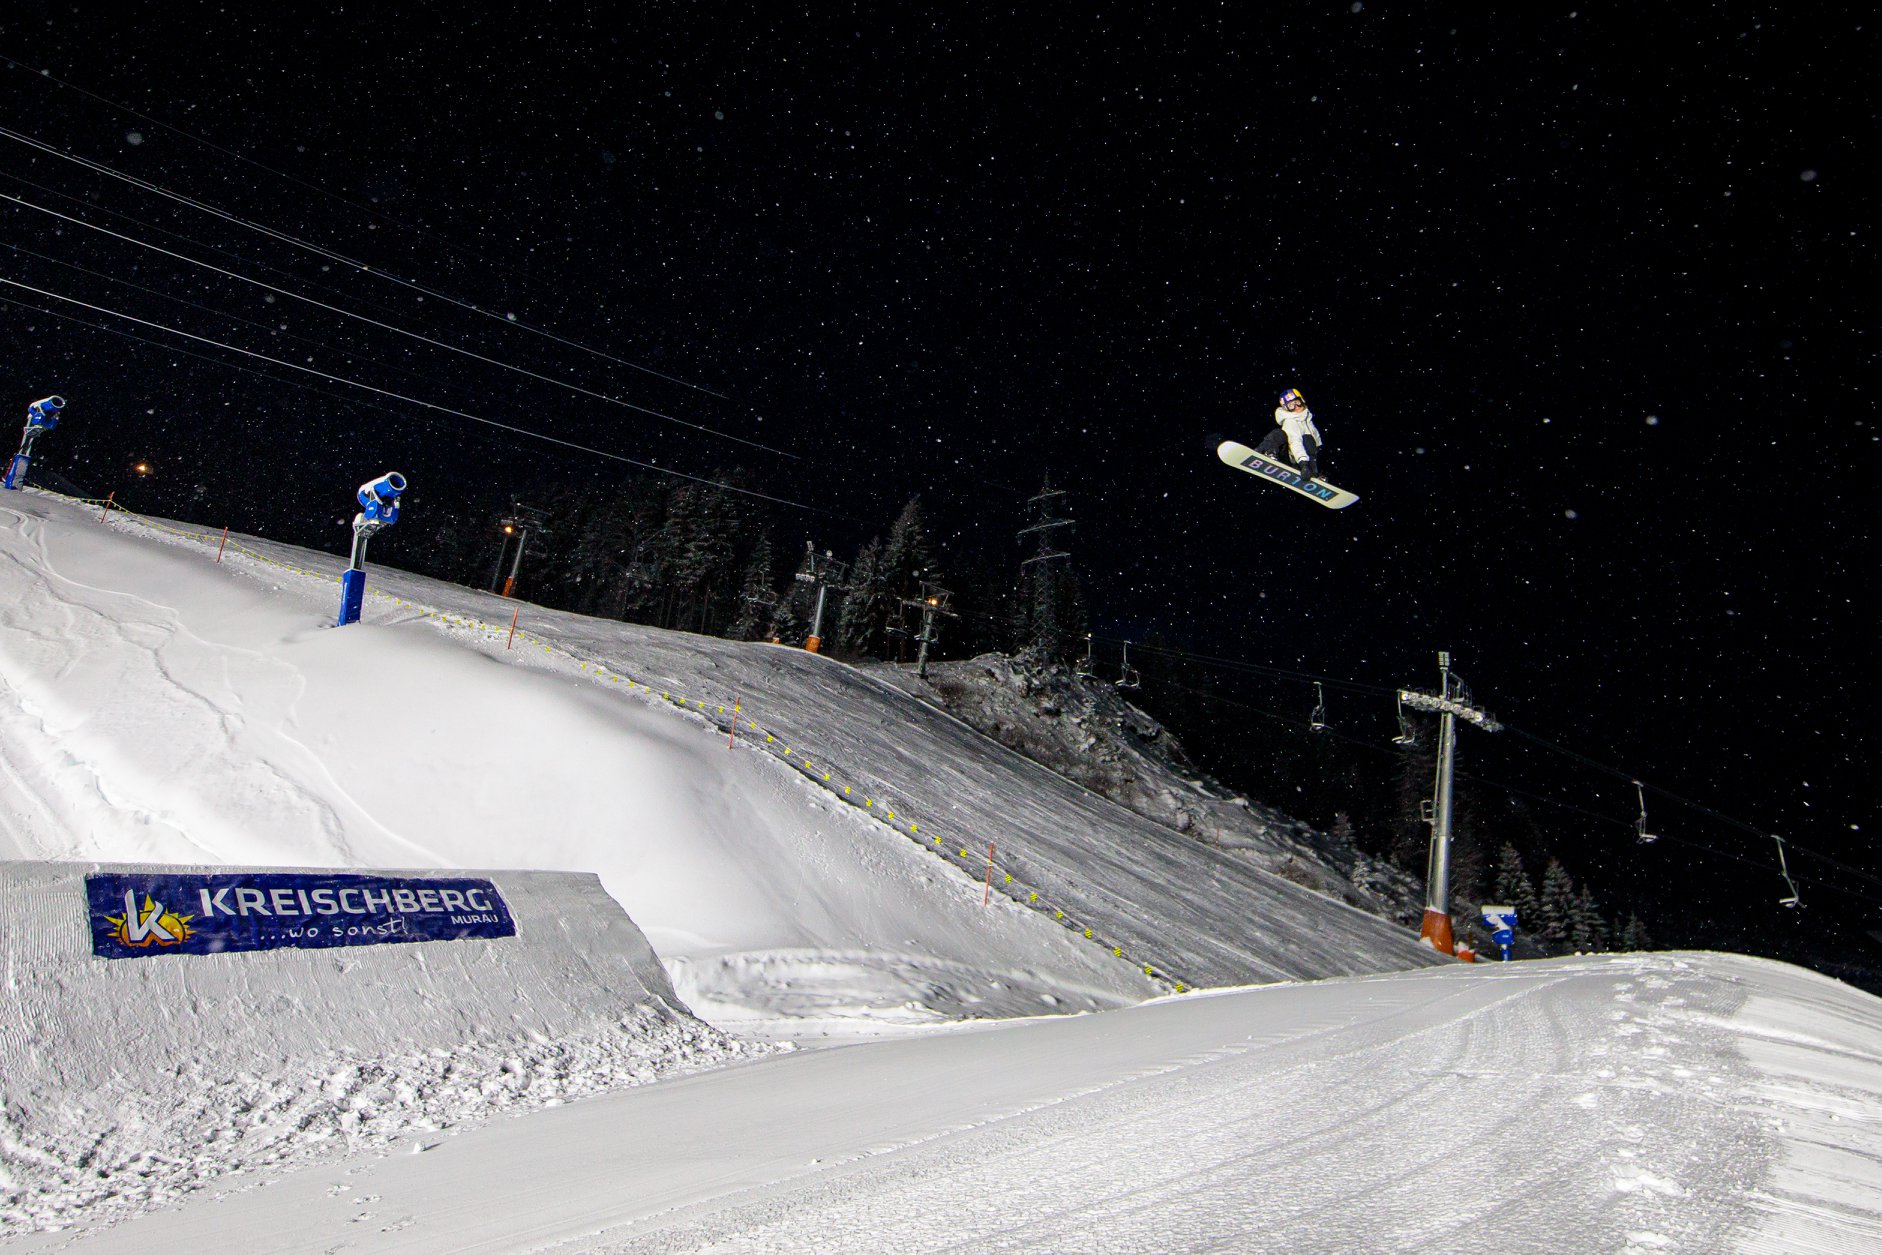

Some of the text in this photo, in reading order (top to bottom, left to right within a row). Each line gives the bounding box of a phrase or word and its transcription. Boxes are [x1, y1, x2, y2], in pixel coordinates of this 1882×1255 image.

[1248, 459, 1332, 498] BURTON
[199, 888, 493, 917] KREISCHBERG
[451, 914, 499, 925] MURAU
